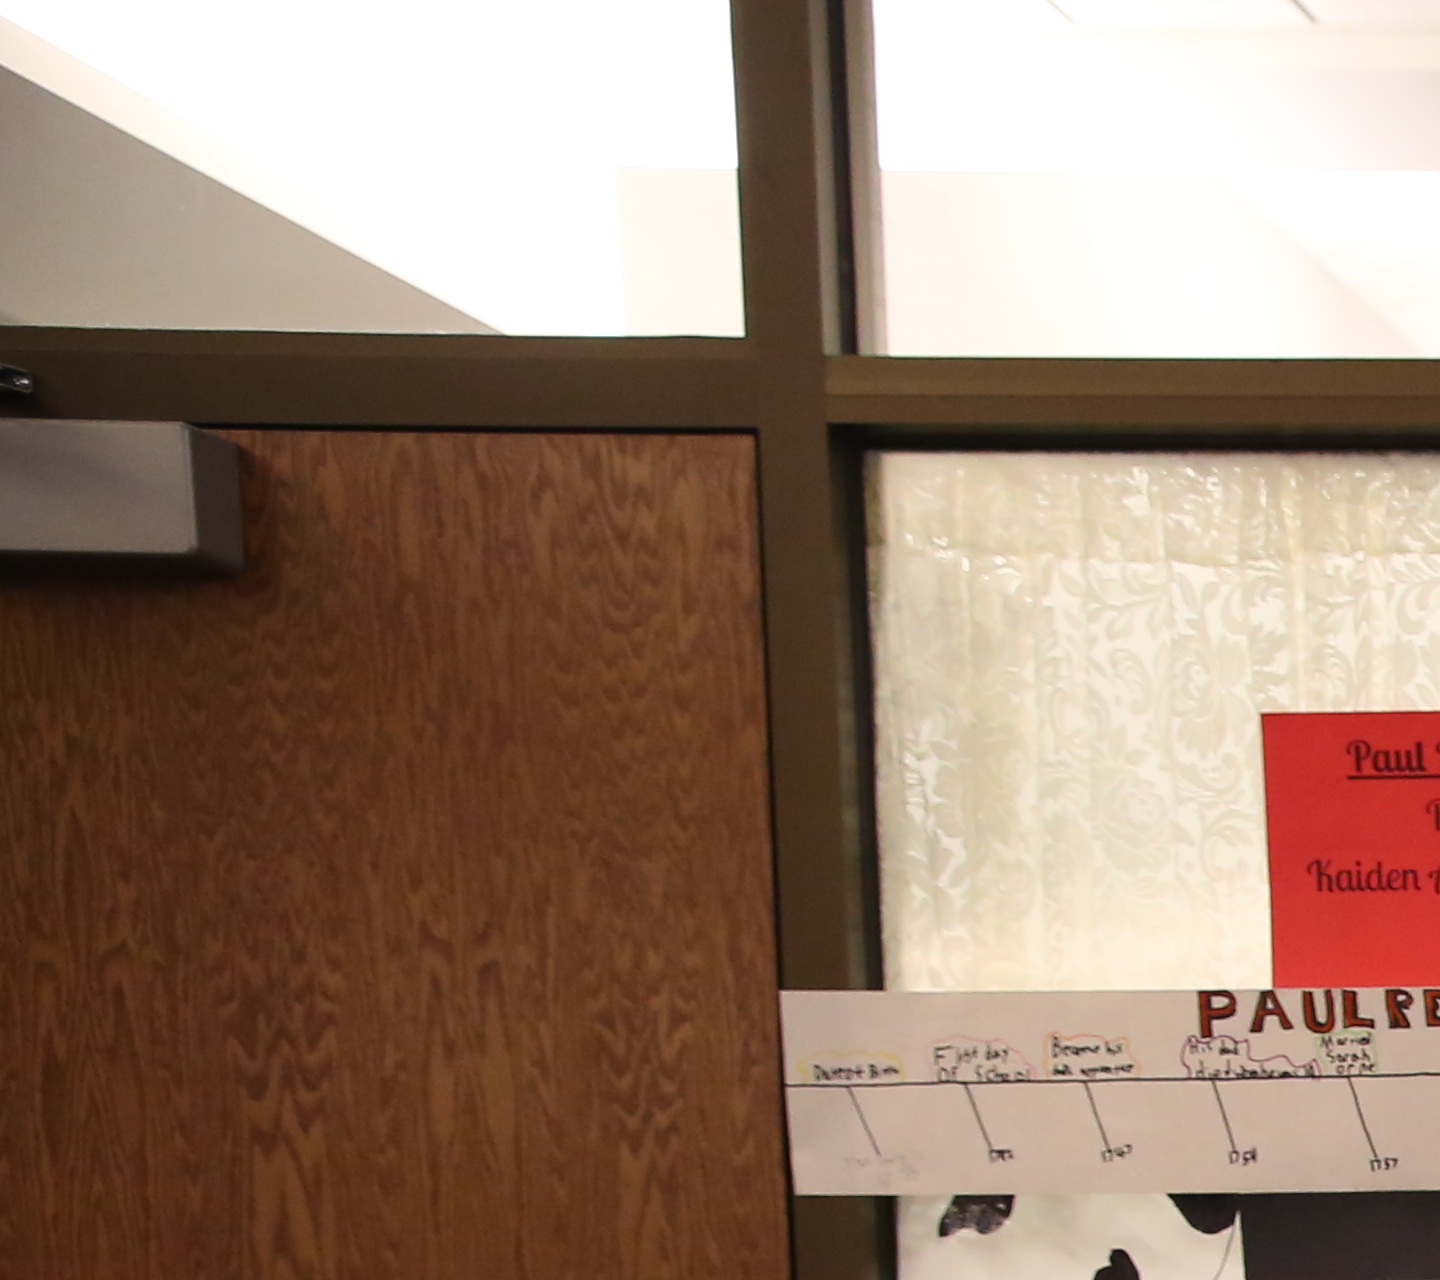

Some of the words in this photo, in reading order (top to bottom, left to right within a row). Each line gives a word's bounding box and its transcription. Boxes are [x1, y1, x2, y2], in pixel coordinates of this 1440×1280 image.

[1345, 738, 1427, 773] Paul
[1306, 857, 1422, 893] Kaiden
[1195, 987, 1376, 1039] PAUL
